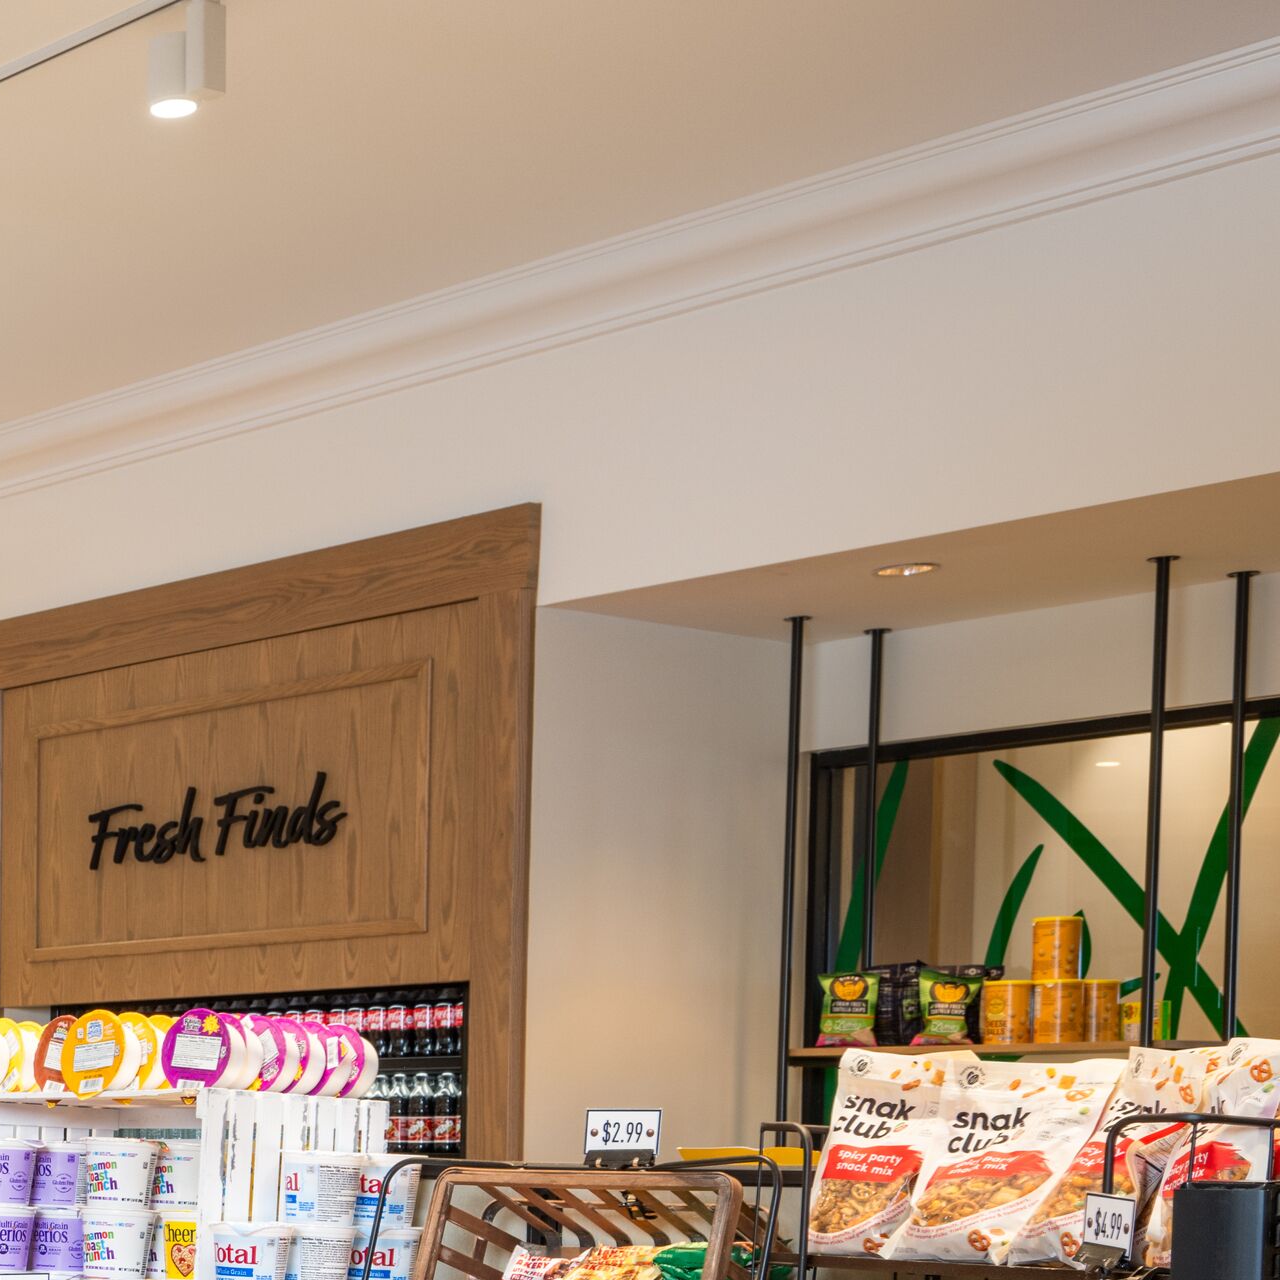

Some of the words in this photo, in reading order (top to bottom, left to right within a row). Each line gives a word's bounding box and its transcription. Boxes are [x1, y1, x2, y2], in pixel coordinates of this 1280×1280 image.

[88, 786, 206, 871] Fresh
[214, 771, 348, 856] Finds
[845, 1095, 916, 1120] snak
[952, 1107, 1031, 1131] snak
[601, 1119, 643, 1145] $2.99
[833, 1115, 891, 1139] club
[836, 1161, 868, 1173] snack
[871, 1166, 894, 1176] mix
[837, 1150, 867, 1161] spicy
[869, 1152, 903, 1166] party
[13, 1221, 28, 1229] Grain
[1094, 1207, 1123, 1240] $4.99
